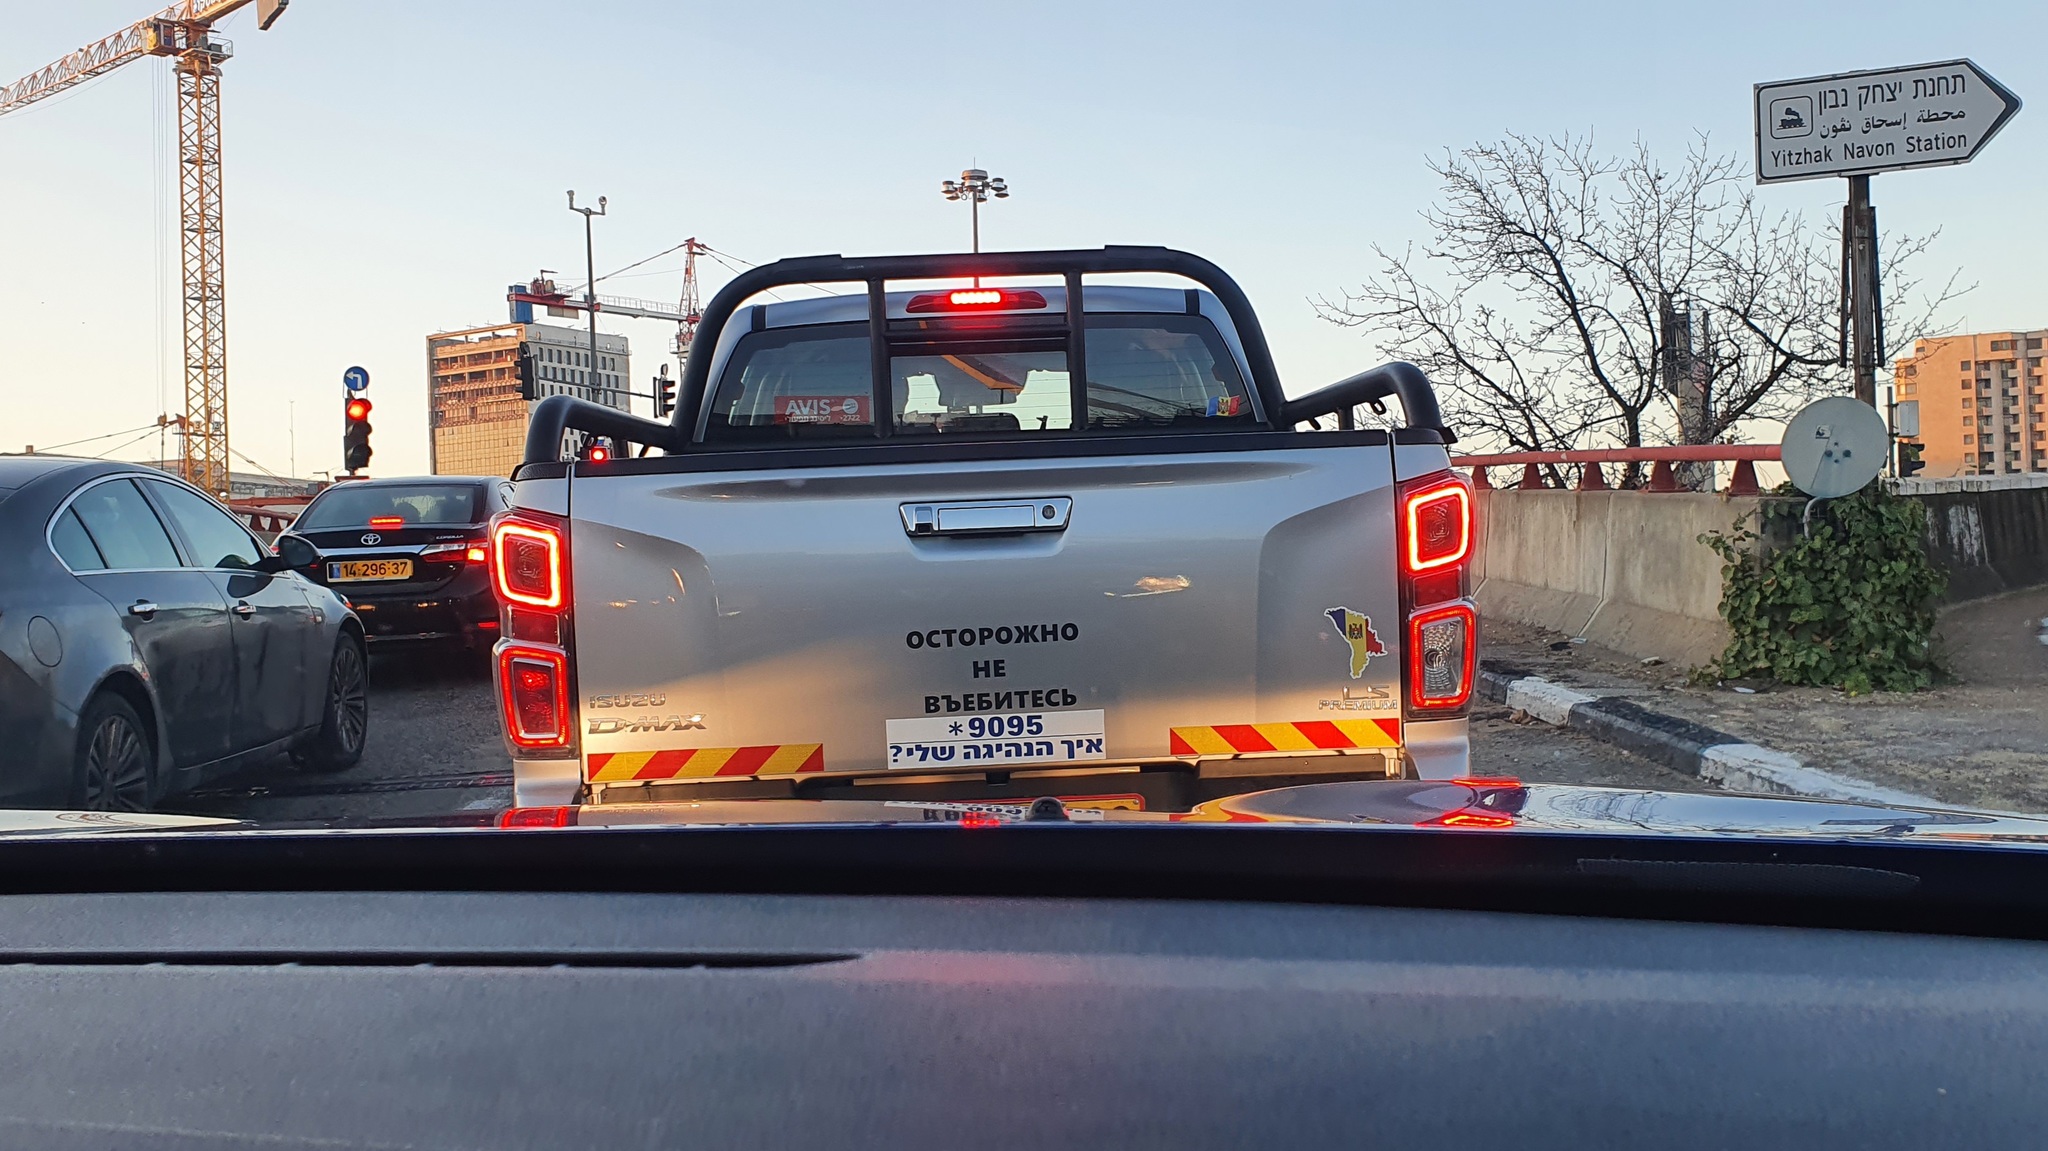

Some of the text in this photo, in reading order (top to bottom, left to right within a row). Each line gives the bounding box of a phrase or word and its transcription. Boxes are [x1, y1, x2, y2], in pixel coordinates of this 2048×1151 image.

[1818, 73, 1967, 116] תחנת יצחק נבון
[1861, 112, 1907, 134] إسحاق
[1916, 109, 1966, 123] محطة
[1771, 132, 1967, 168] Yitzhak Navon Station
[785, 399, 831, 415] AVIS
[906, 622, 1079, 649] ОСТОРОЖНО
[972, 659, 1007, 679] НЕ
[589, 693, 667, 709] ISUZU
[924, 688, 1077, 714] ВЪЕБИТЕСЬ
[1342, 685, 1390, 699] LS
[1318, 699, 1398, 710] PREMIUM
[889, 738, 1104, 763] איך הנהיגה שלי?
